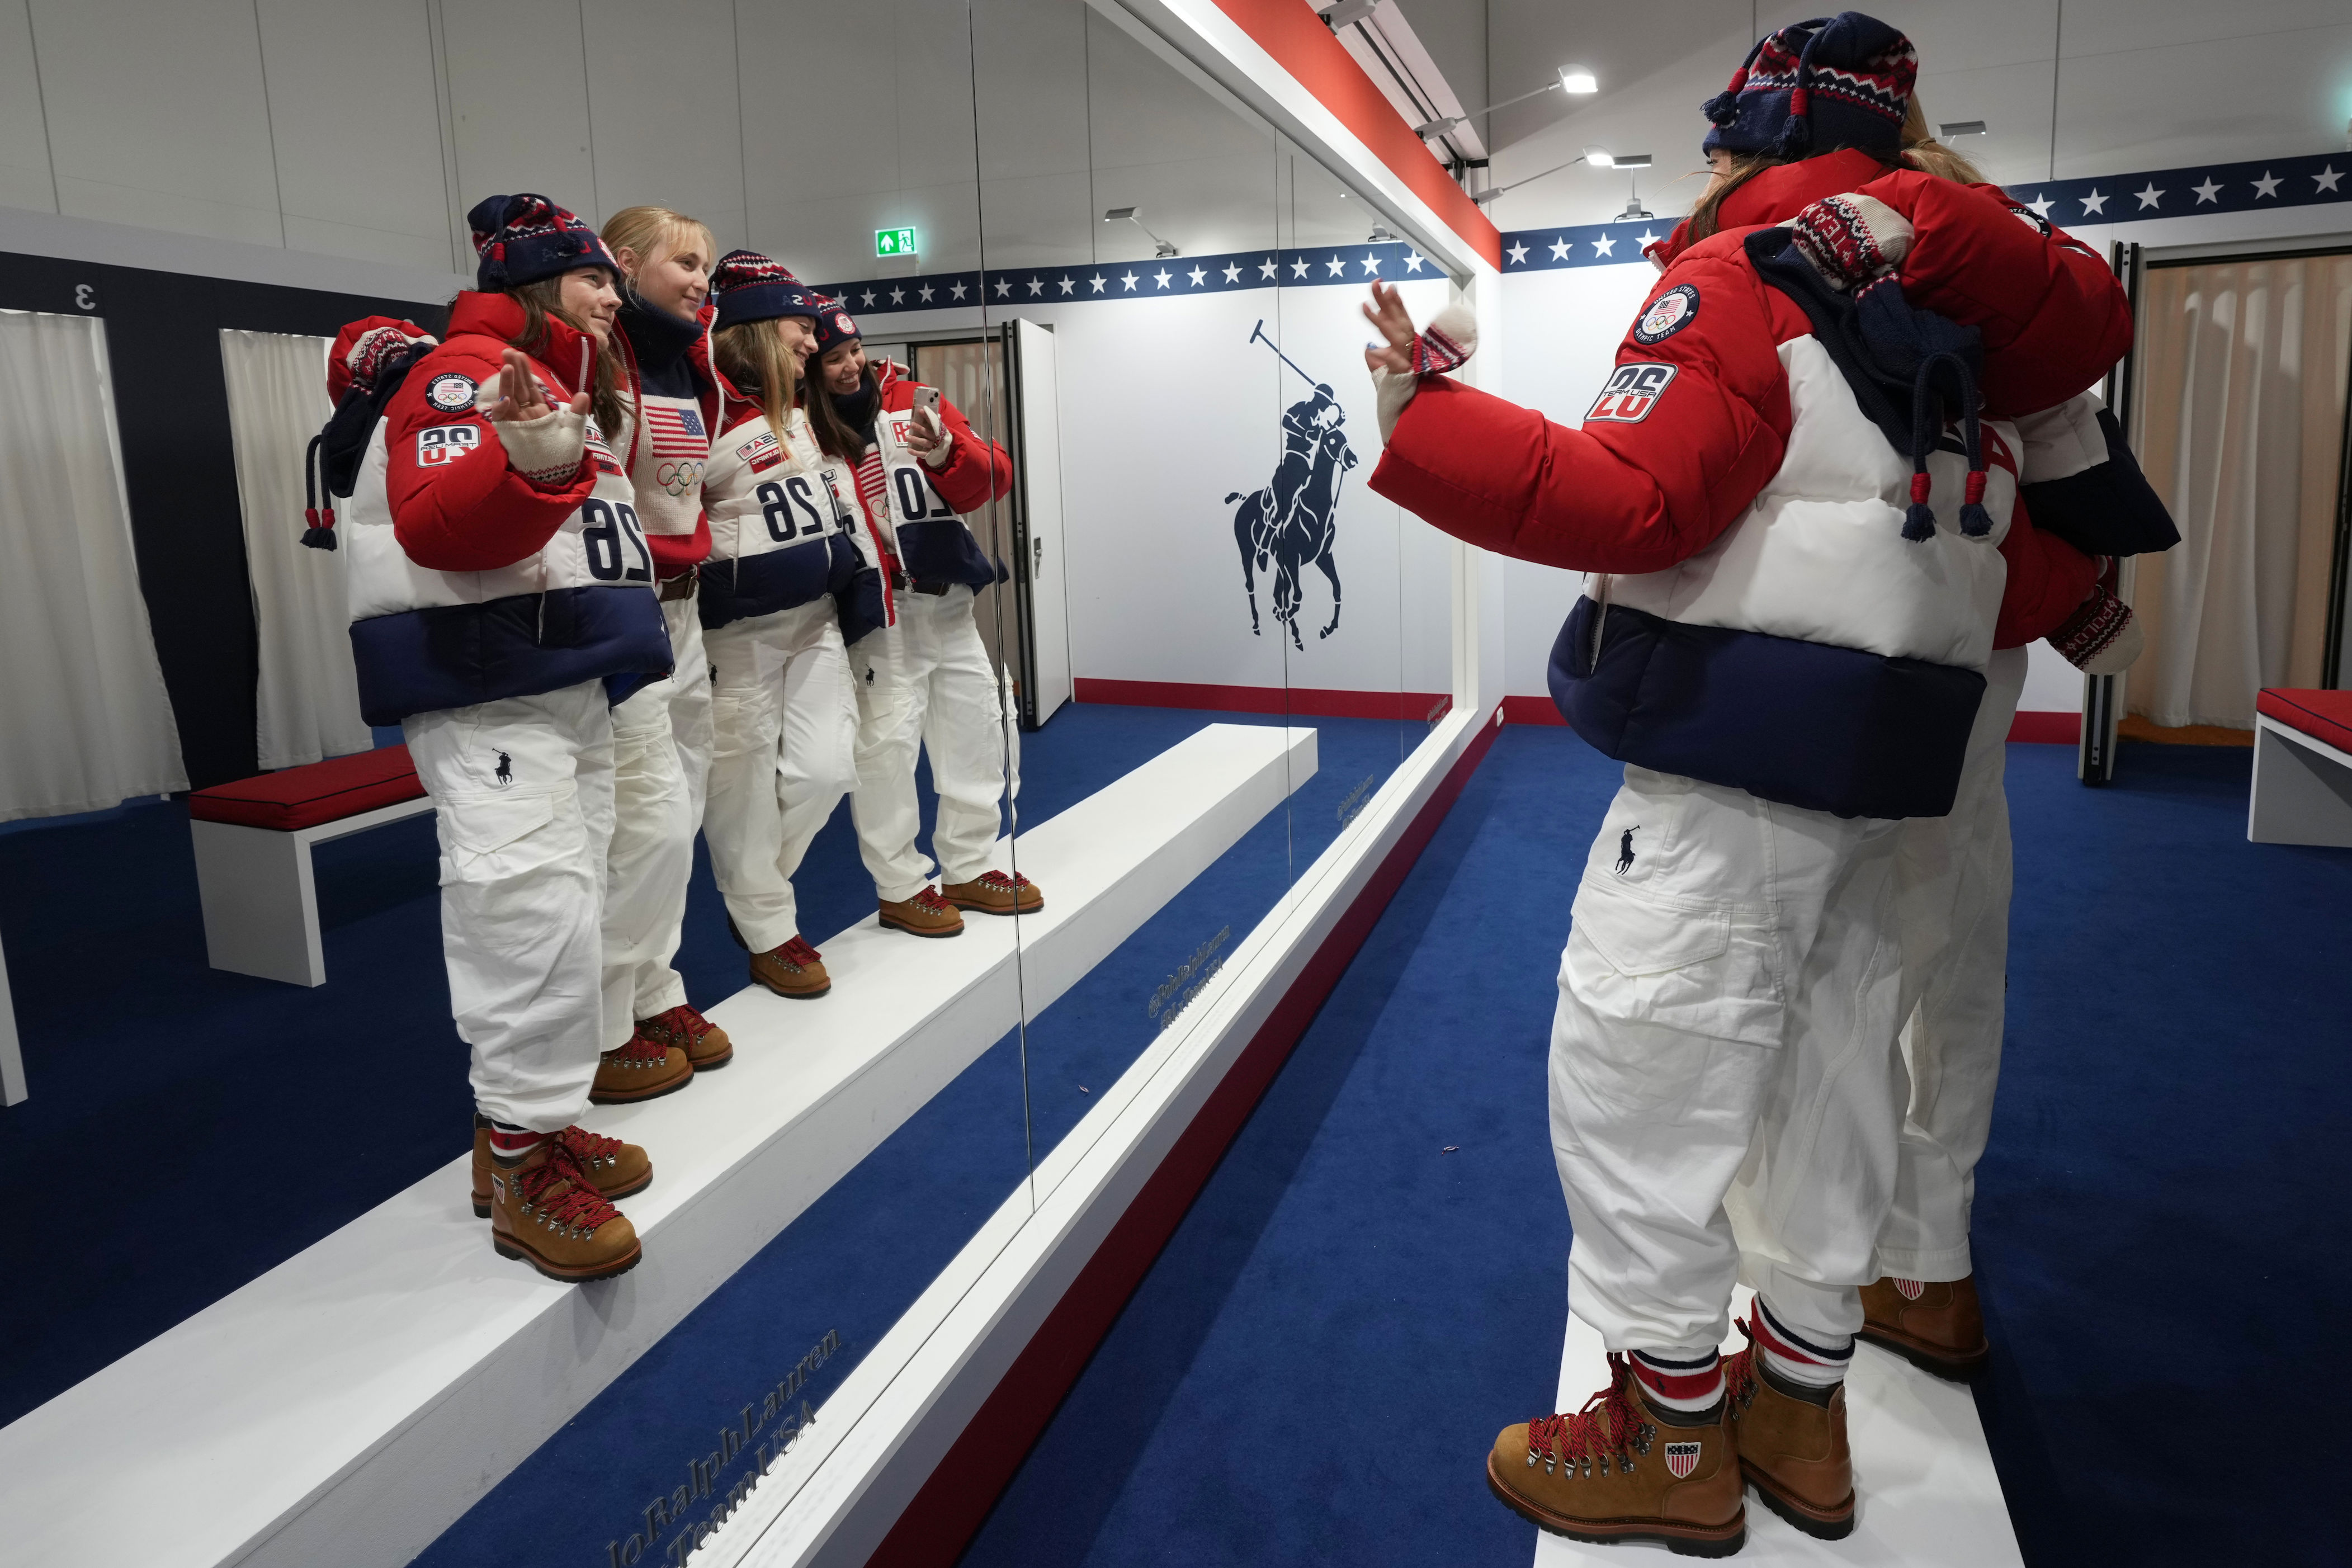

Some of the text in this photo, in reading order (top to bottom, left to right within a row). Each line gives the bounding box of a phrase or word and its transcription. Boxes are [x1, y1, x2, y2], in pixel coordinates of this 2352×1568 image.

[1654, 286, 1695, 304] UNITED STATES
[1635, 326, 1676, 342] OLYMPIC TEAM
